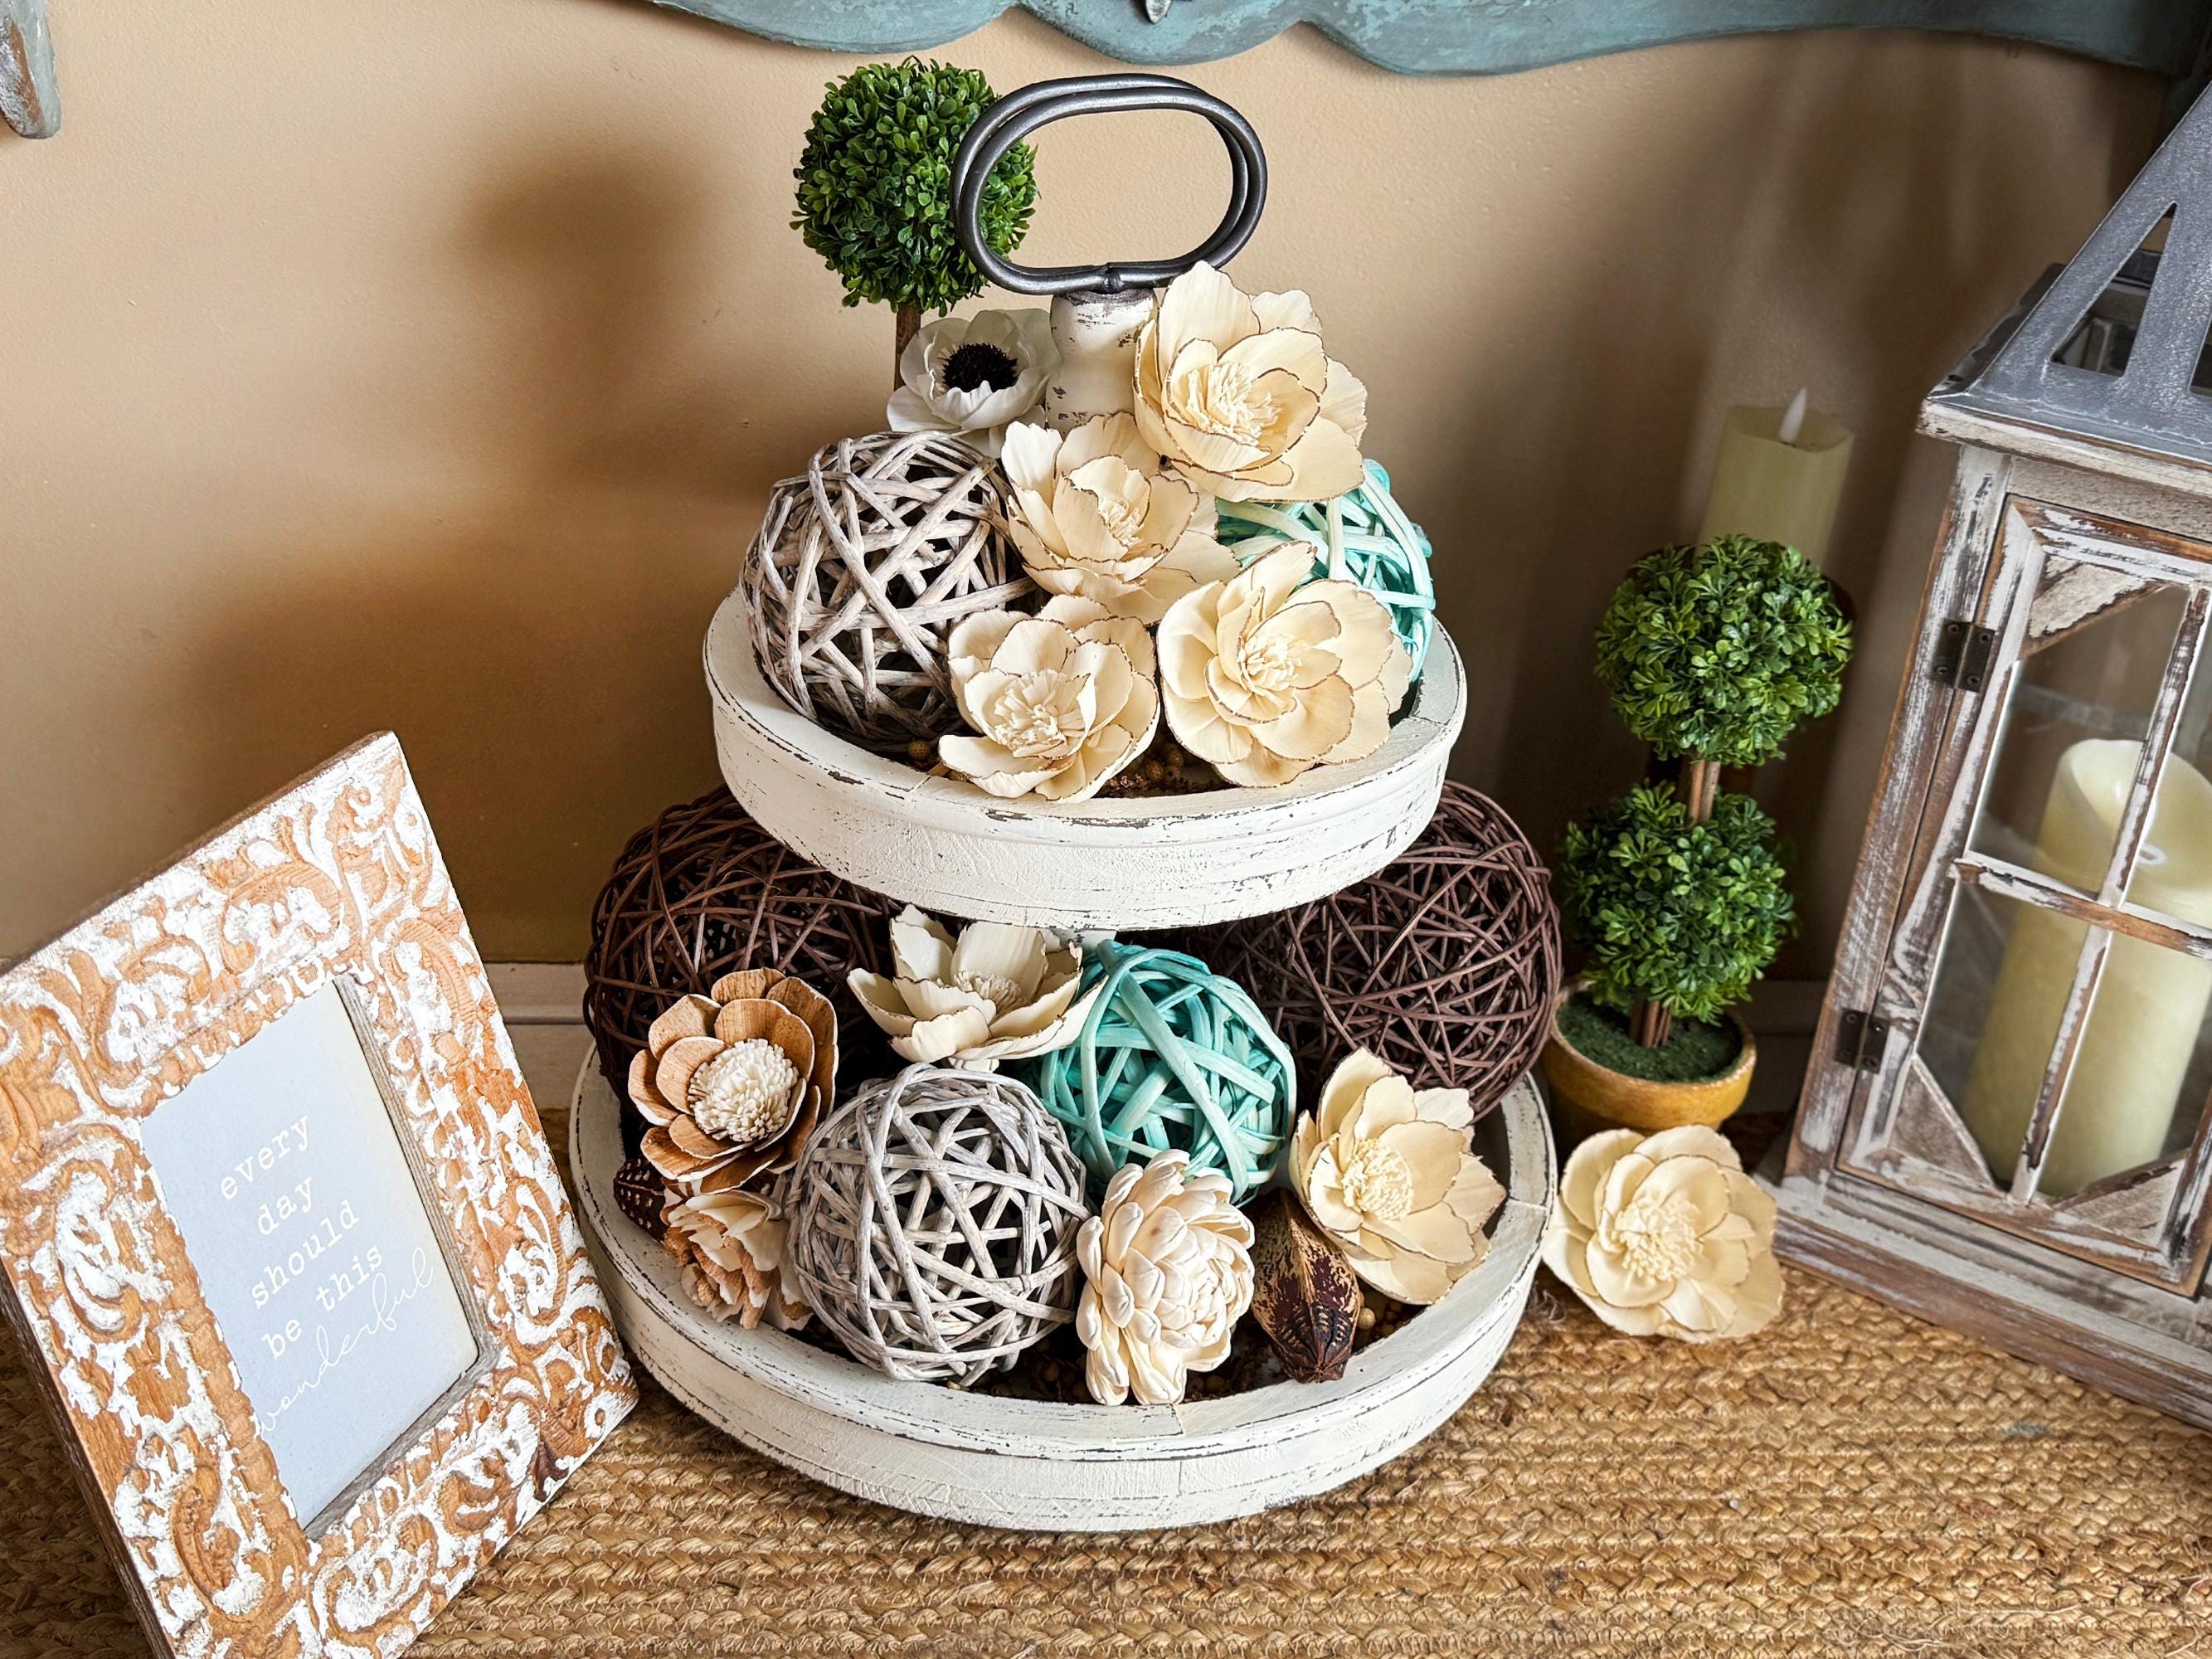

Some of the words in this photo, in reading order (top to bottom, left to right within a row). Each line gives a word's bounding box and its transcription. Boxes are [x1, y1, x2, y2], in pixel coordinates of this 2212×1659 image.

[221, 1115, 310, 1199] every
[257, 1177, 313, 1235] day
[251, 1200, 359, 1309] should
[262, 1318, 301, 1359] be
[316, 1244, 382, 1311] this
